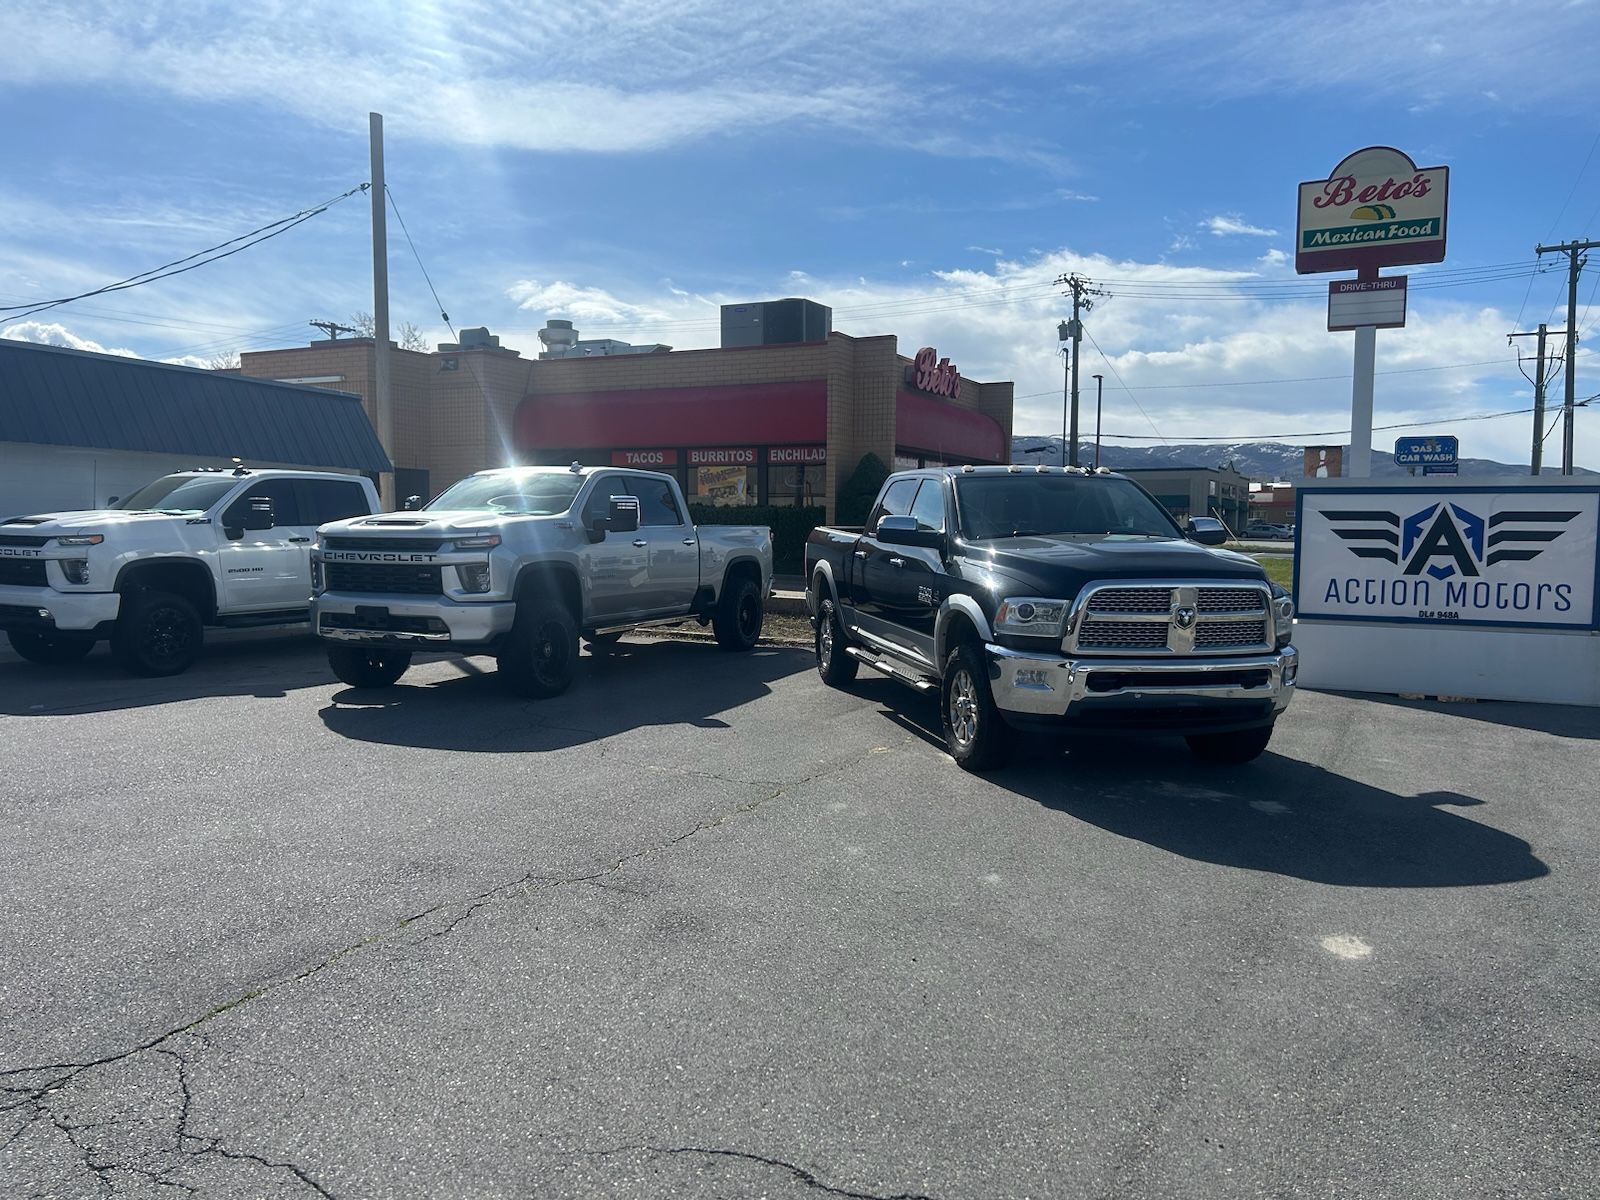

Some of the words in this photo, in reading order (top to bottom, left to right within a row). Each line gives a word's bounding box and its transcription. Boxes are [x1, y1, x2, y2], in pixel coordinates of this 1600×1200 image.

[1313, 173, 1431, 208] Beto's
[1310, 227, 1385, 246] Mexican
[1387, 221, 1432, 238] Food
[1340, 281, 1397, 292] DRIVE-THRU
[626, 452, 664, 464] TACOS
[691, 450, 754, 463] BURRITOS
[1399, 454, 1420, 462] CAR
[1423, 453, 1453, 462] WASH
[324, 552, 437, 562] CHEVROLET
[1418, 610, 1435, 618] DL#
